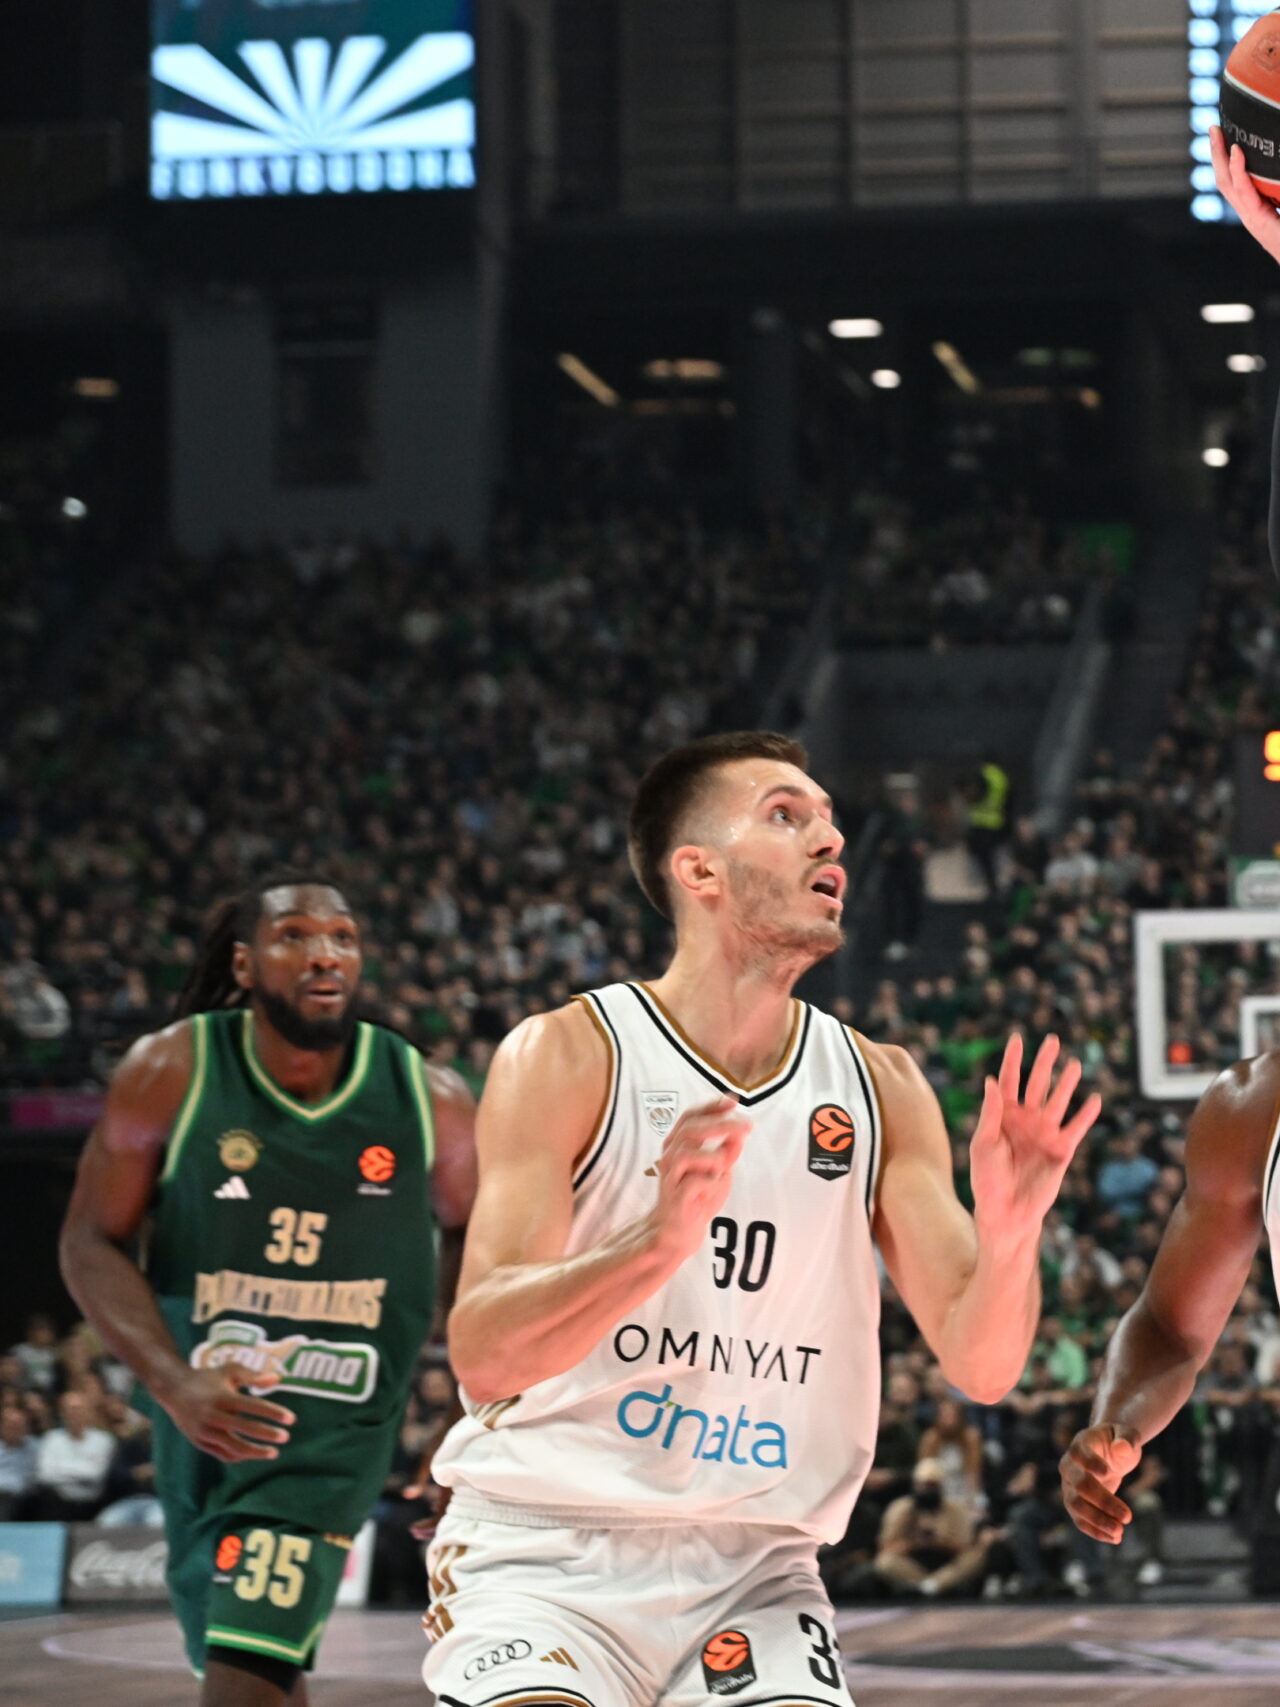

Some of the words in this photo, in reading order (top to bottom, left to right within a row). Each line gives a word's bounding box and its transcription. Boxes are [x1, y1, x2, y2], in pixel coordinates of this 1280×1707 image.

[264, 1207, 328, 1267] 35
[710, 1216, 776, 1292] 30
[616, 1383, 788, 1469] dnata
[234, 1529, 312, 1609] 35
[798, 1612, 842, 1690] 3
